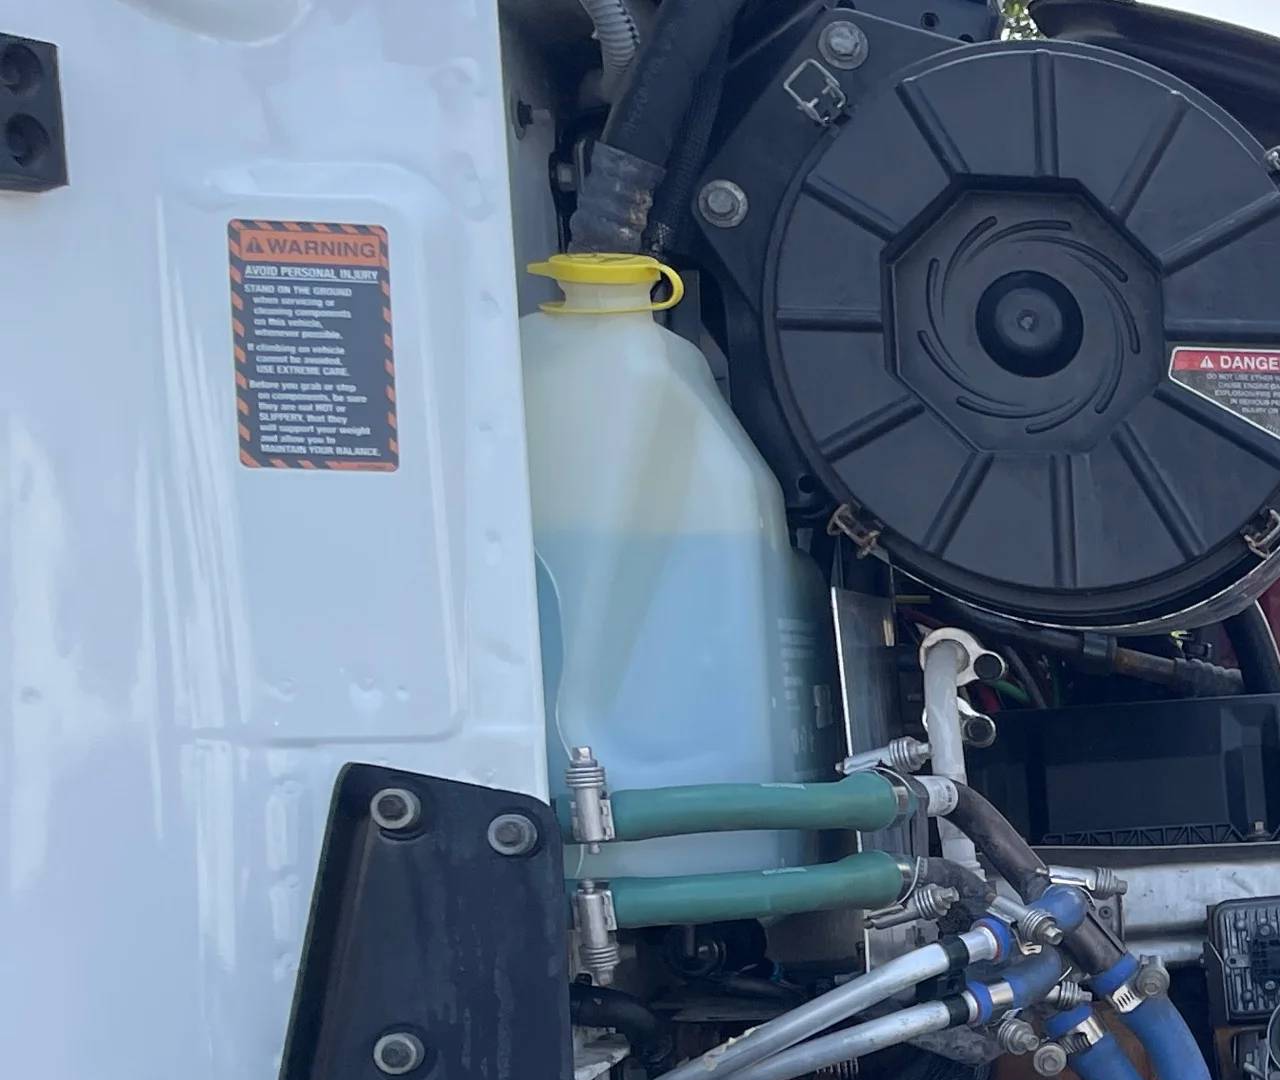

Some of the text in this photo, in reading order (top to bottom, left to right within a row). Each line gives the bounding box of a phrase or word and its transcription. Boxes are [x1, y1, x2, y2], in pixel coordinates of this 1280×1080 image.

[267, 238, 377, 259] WARNING
[245, 265, 379, 280] AVOID PERSONAL INJURY
[243, 284, 353, 297] STAND ON THE GROUND
[255, 364, 275, 374] USE
[276, 365, 320, 375] EXTREME
[260, 443, 307, 454] MAINTAIN
[309, 445, 334, 455] YOUR
